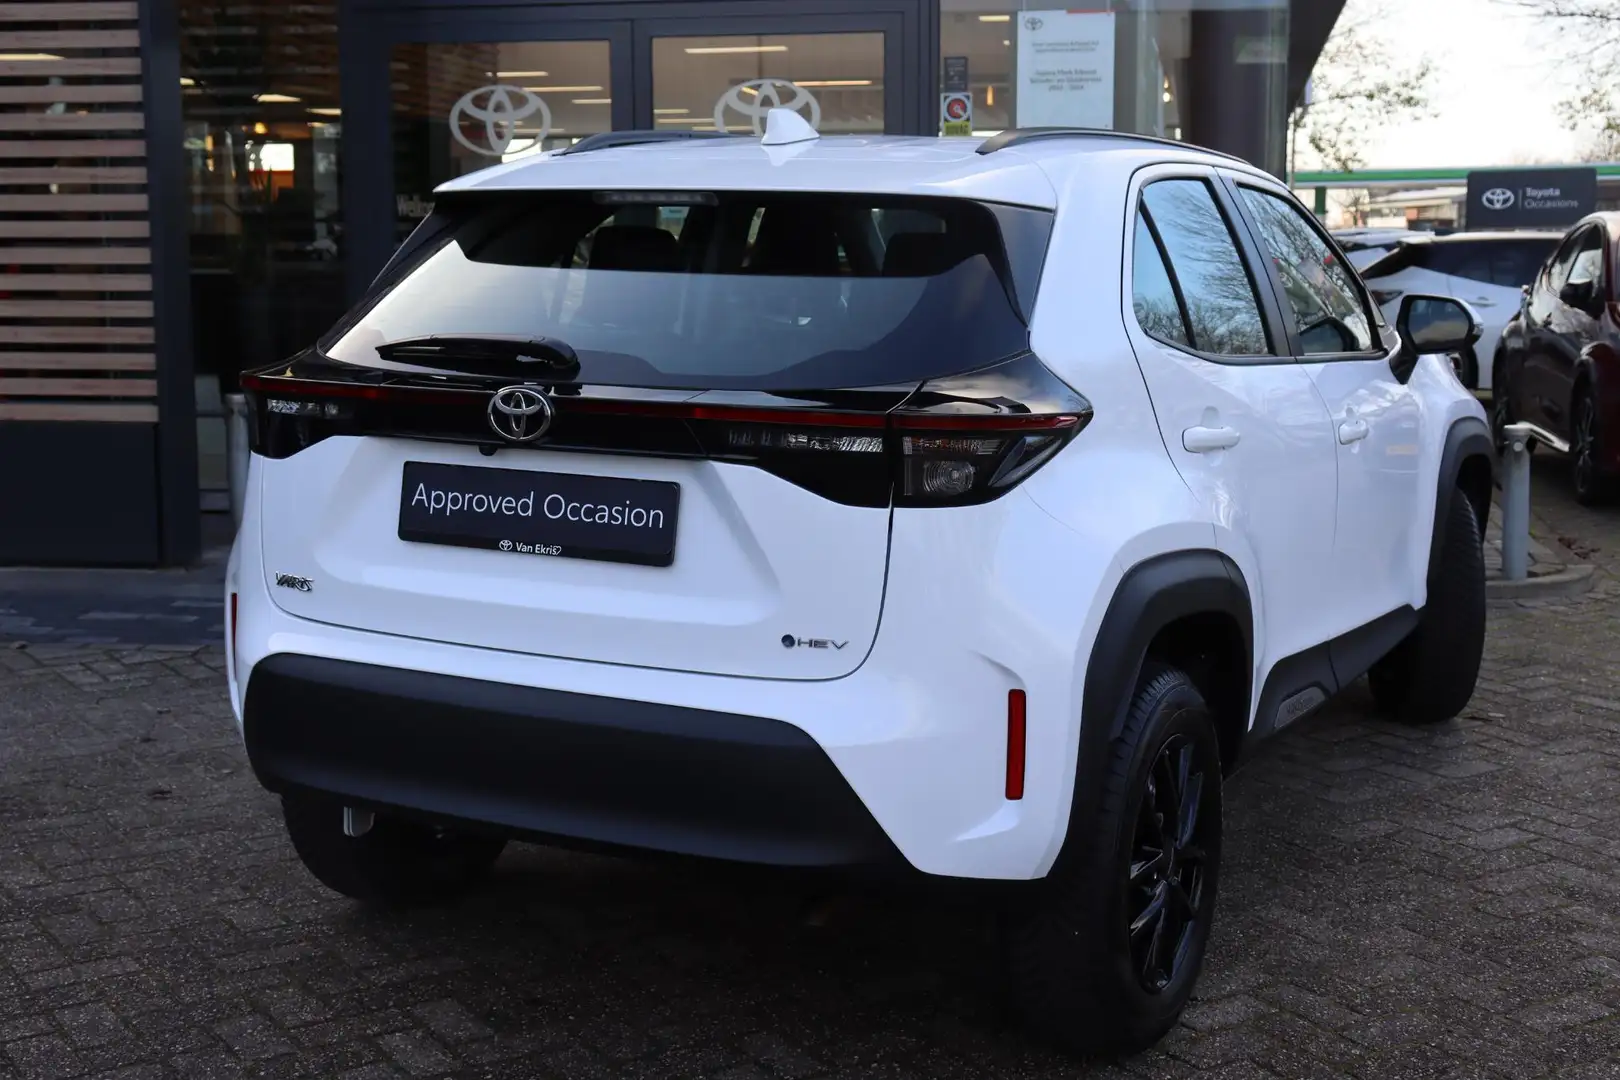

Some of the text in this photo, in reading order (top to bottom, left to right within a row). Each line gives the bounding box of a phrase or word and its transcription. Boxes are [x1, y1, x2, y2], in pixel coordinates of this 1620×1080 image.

[1525, 187, 1561, 199] Toyota
[1524, 199, 1580, 209] Occasions
[411, 482, 665, 529] Approved Occasion
[515, 541, 557, 556] Van Ekris
[797, 637, 849, 651] HEV
